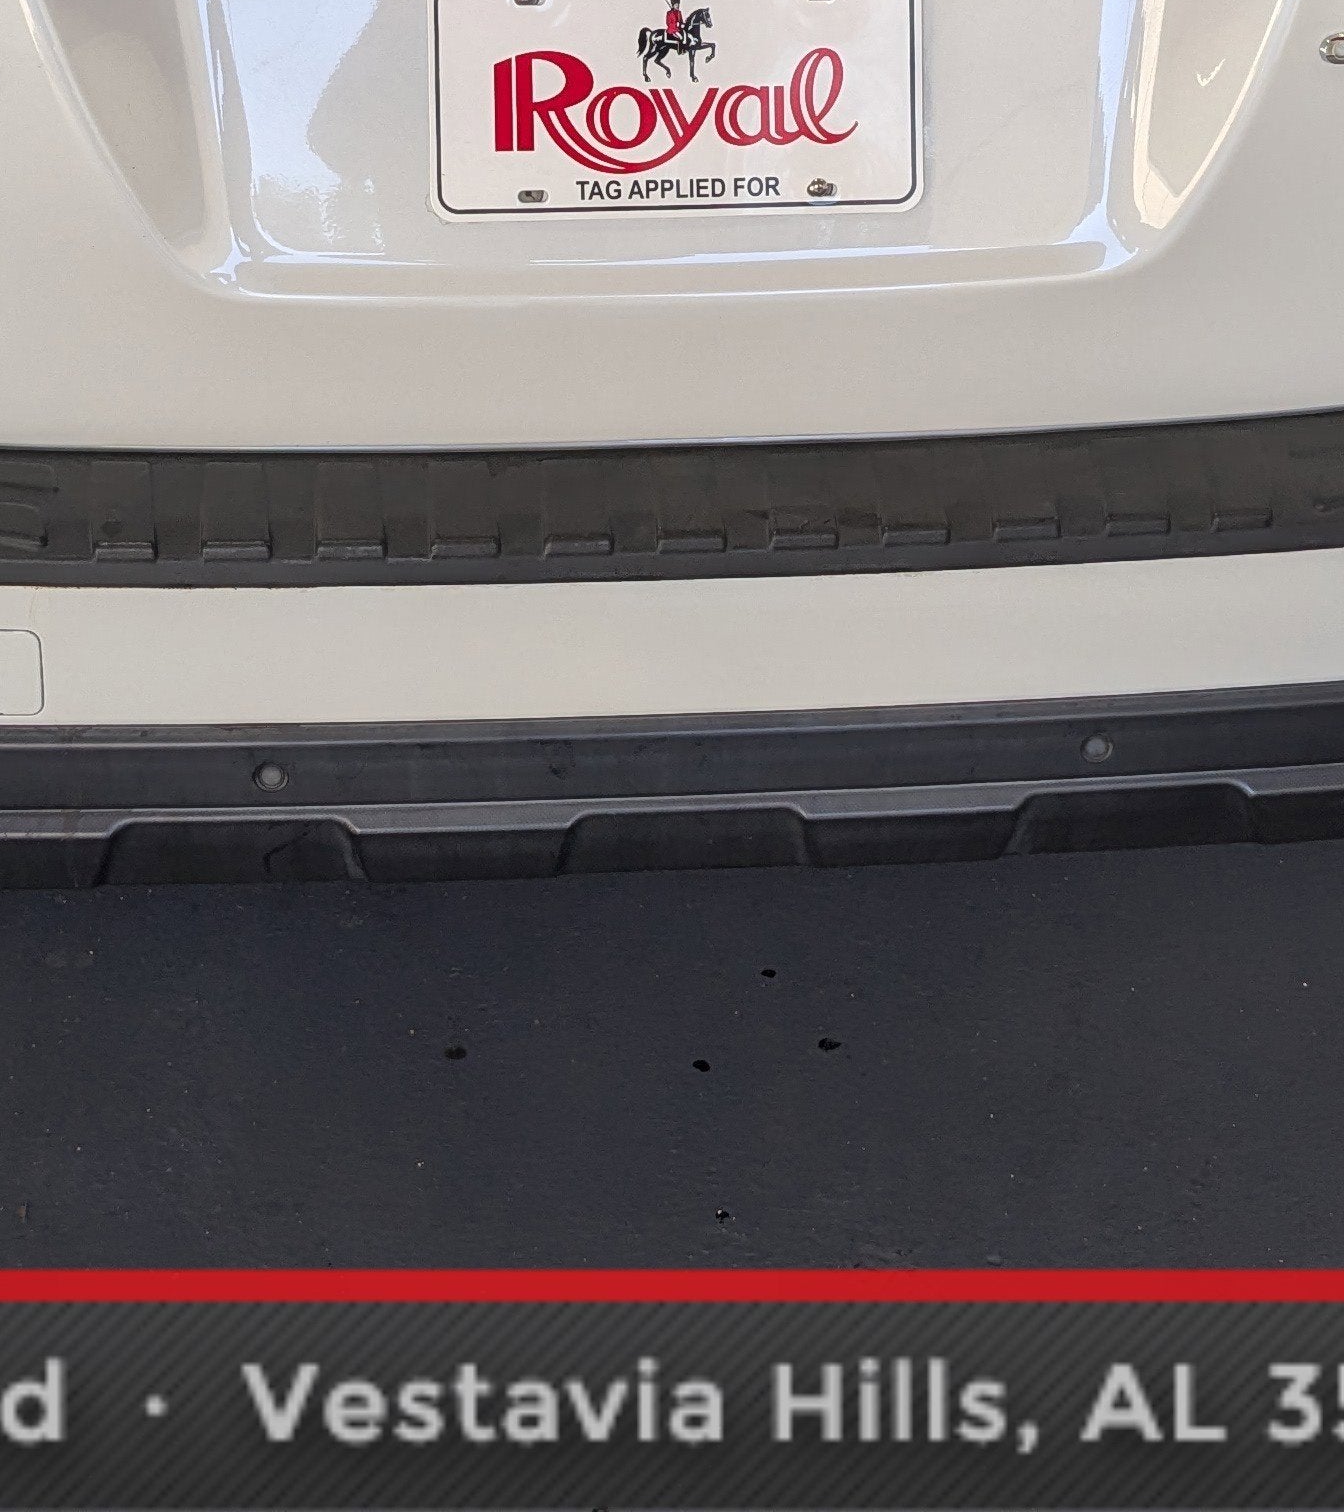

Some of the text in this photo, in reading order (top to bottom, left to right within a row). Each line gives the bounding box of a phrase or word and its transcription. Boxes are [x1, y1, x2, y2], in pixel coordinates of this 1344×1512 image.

[493, 47, 859, 175] Royal
[576, 175, 781, 202] TAG APPLIED FOR
